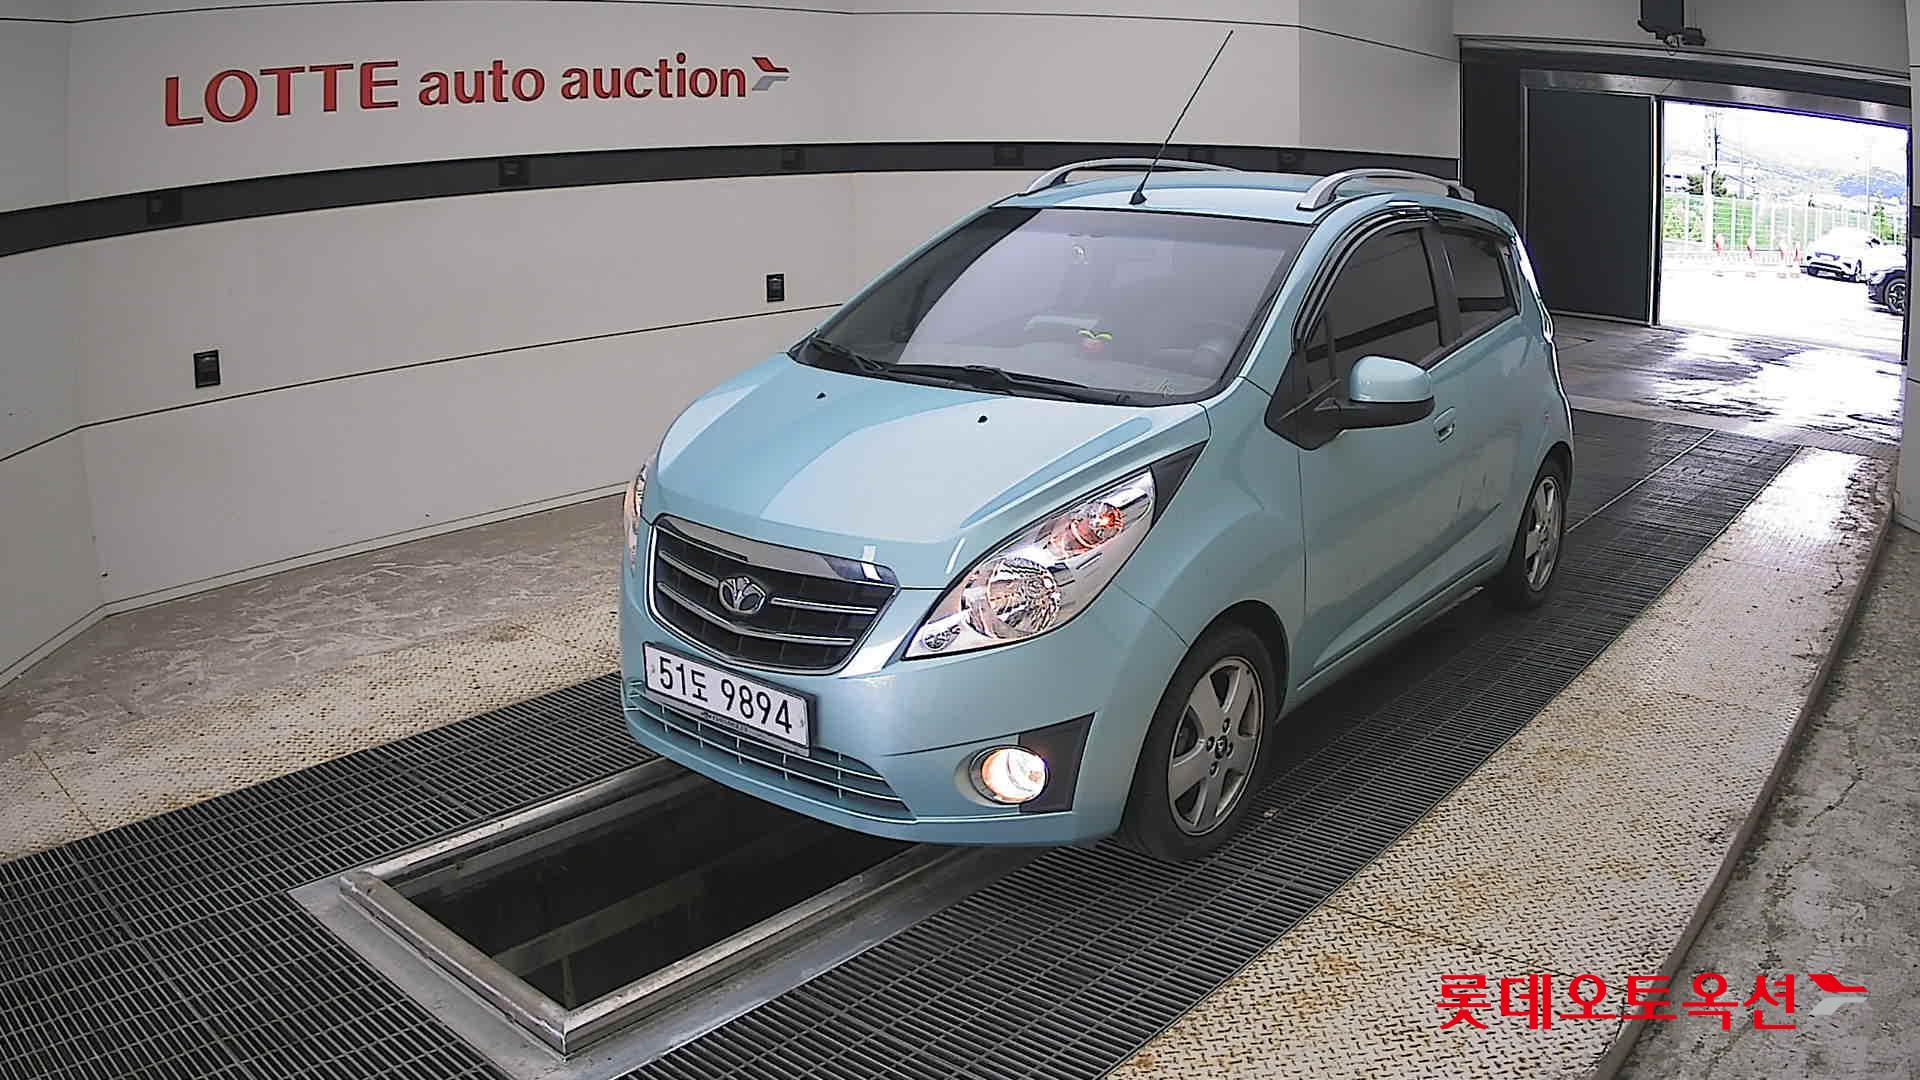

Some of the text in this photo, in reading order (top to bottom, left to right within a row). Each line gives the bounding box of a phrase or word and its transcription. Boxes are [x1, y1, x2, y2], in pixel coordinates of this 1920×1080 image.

[165, 52, 747, 127] LOTTE auto auction
[659, 656, 708, 702] 51도
[720, 678, 793, 734] 9894
